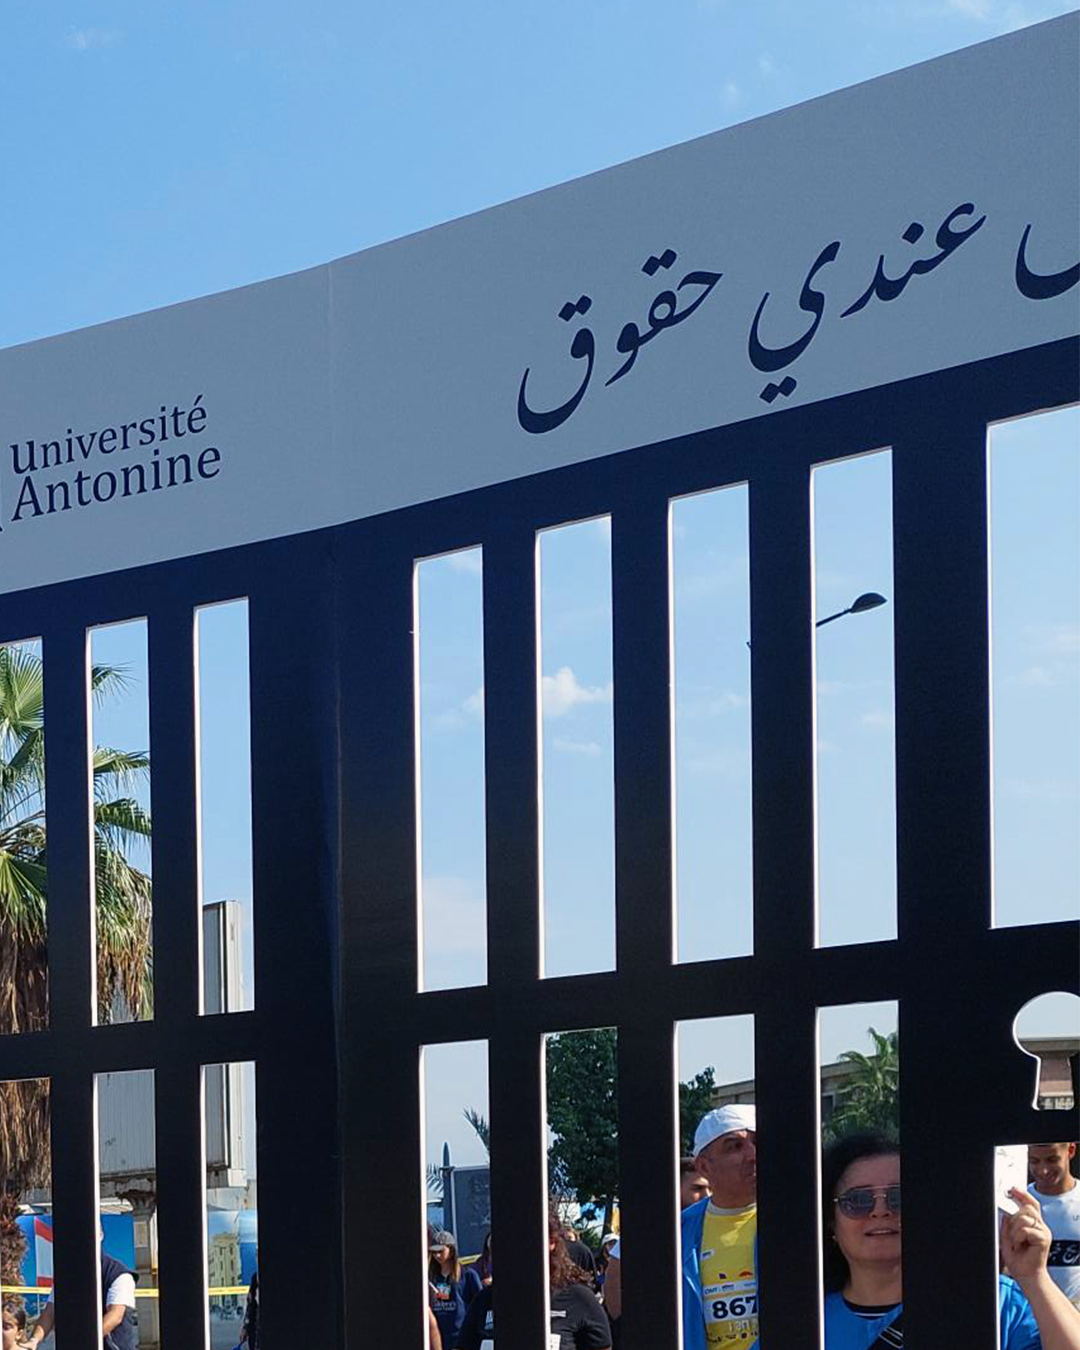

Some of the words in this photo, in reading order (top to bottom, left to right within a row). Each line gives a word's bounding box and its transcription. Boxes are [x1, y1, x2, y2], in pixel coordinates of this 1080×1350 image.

[517, 248, 724, 434] حقوق
[747, 202, 987, 404] عندي
[10, 446, 221, 523] Antonine
